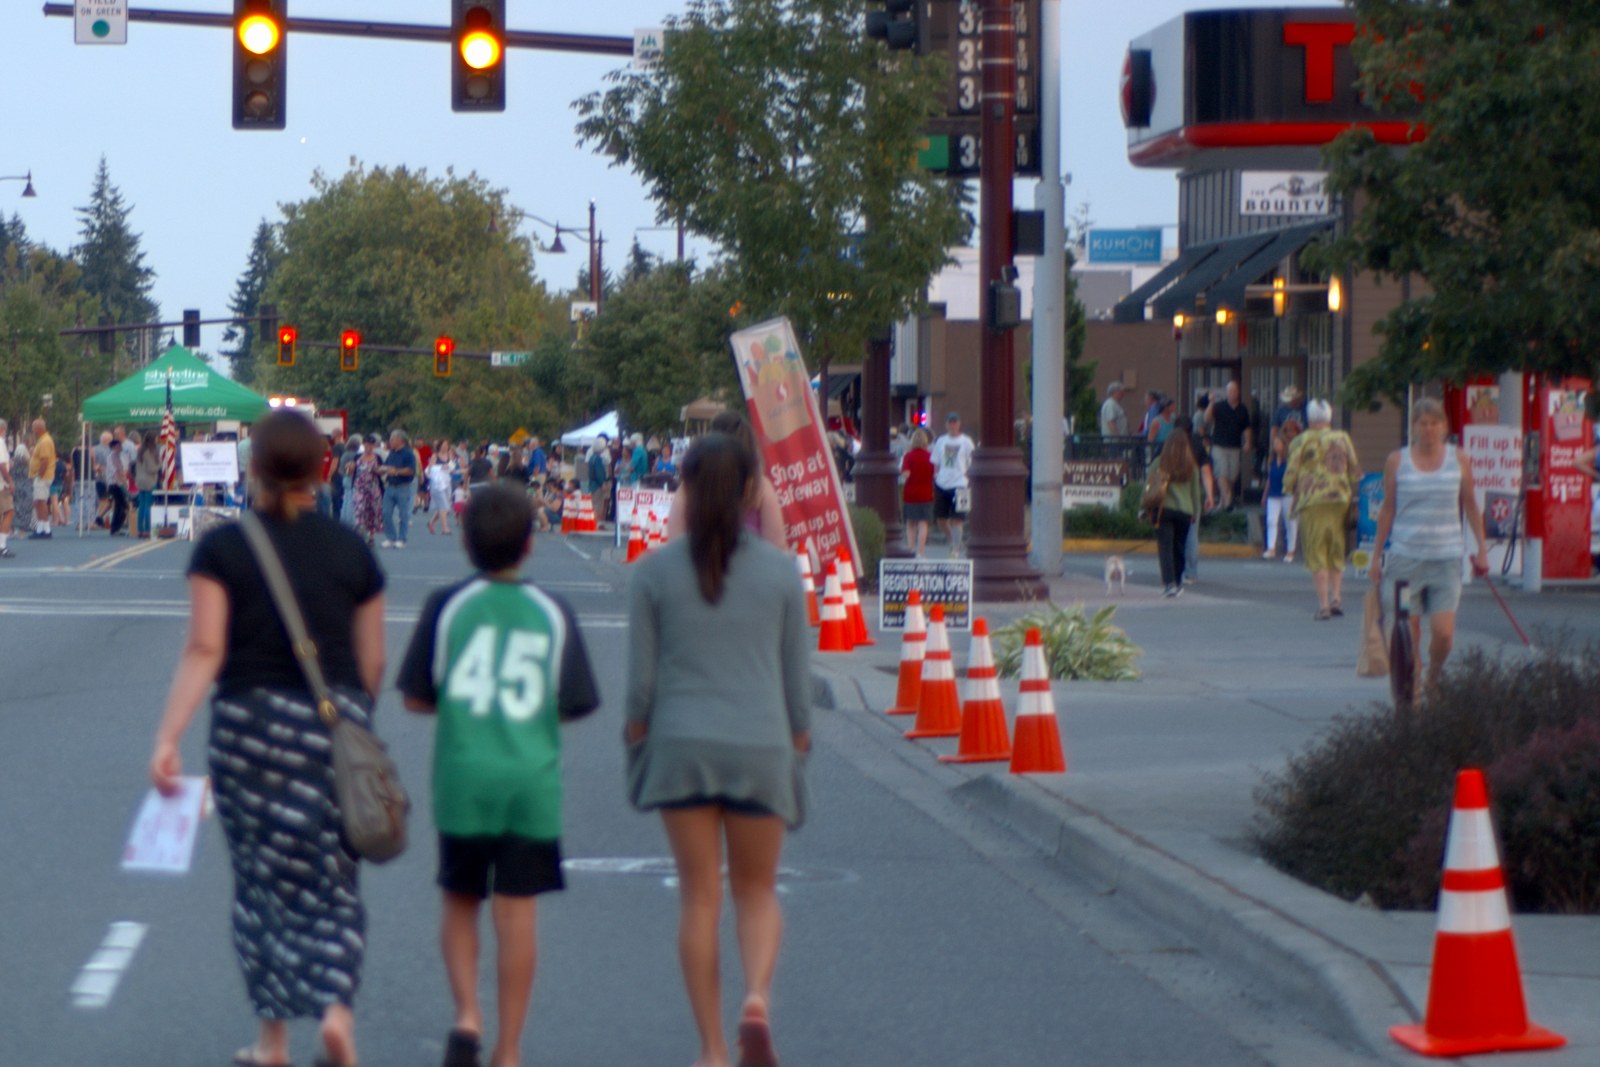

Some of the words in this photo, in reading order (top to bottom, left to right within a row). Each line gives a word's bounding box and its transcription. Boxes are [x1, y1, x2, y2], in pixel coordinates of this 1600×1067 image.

[81, 7, 92, 16] ON
[96, 7, 121, 16] GREEN
[1245, 199, 1325, 212] BOUNTY
[1093, 236, 1155, 252] KUMON
[1470, 436, 1489, 448] Fill
[1493, 438, 1509, 451] up
[770, 461, 805, 486] Shop
[807, 451, 826, 471] at
[776, 475, 830, 507] Safeway
[1064, 487, 1114, 498] PARKING
[808, 515, 825, 532] up
[825, 510, 840, 525] to
[884, 574, 944, 592] REGISTRATION
[945, 574, 970, 592] OPEN
[448, 624, 551, 722] 45
